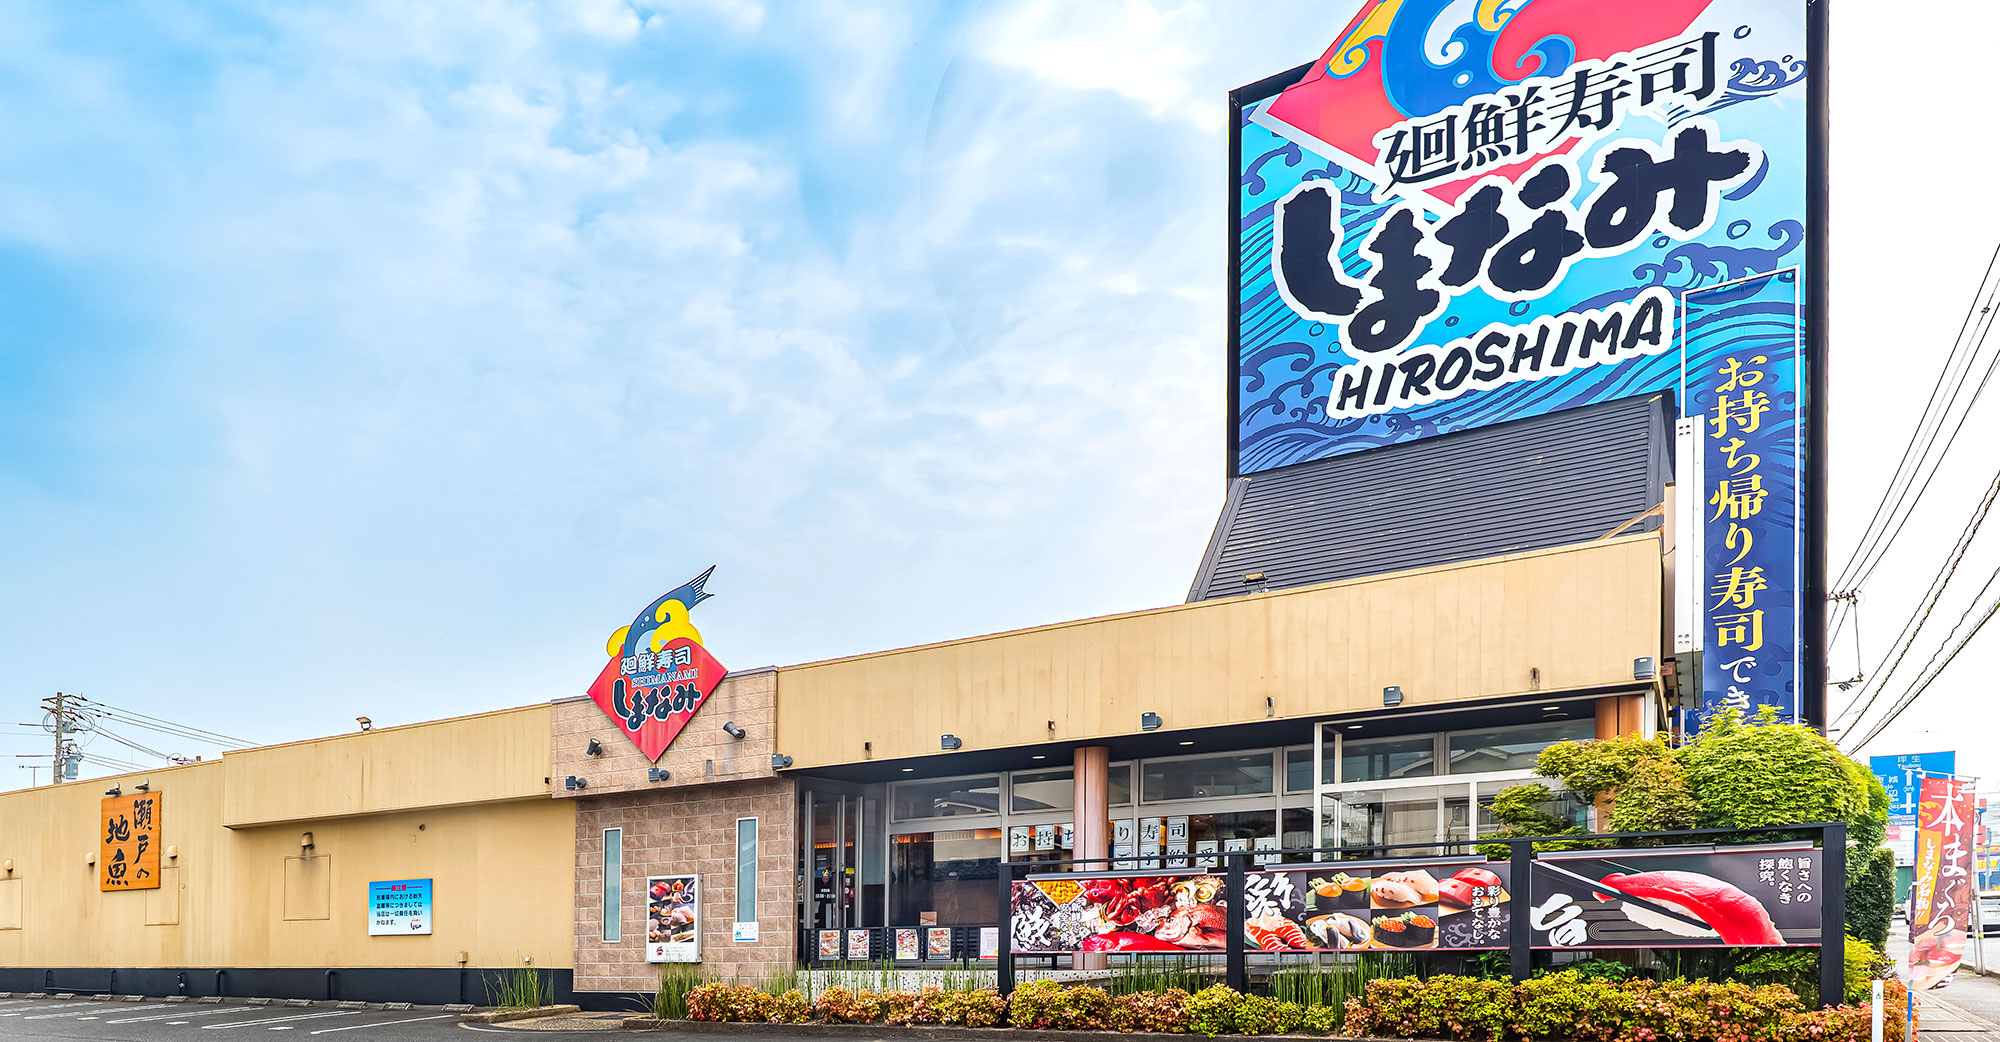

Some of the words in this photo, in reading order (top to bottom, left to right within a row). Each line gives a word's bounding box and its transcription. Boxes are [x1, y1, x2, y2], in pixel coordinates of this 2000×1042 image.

[1383, 31, 1719, 194] 廻鮮寿司
[1279, 125, 1750, 353] しまなみ
[1336, 297, 1663, 410] HIROSHIMA
[620, 645, 691, 676] 廻鮮寿司
[632, 668, 698, 688] SHIMANAMI
[613, 678, 702, 731] しまなみ
[106, 814, 130, 886] 地魚
[133, 799, 153, 879] 瀬戸の
[1012, 823, 1187, 847] お持ちり寿司
[1926, 783, 1968, 936] 本まぐろ
[1759, 858, 1775, 886] 探究。
[1777, 857, 1794, 904] 飽くなき
[1797, 857, 1813, 903] 旨さへの
[1471, 886, 1485, 945] おもてなし。
[1487, 885, 1501, 940] 彩り豊かな
